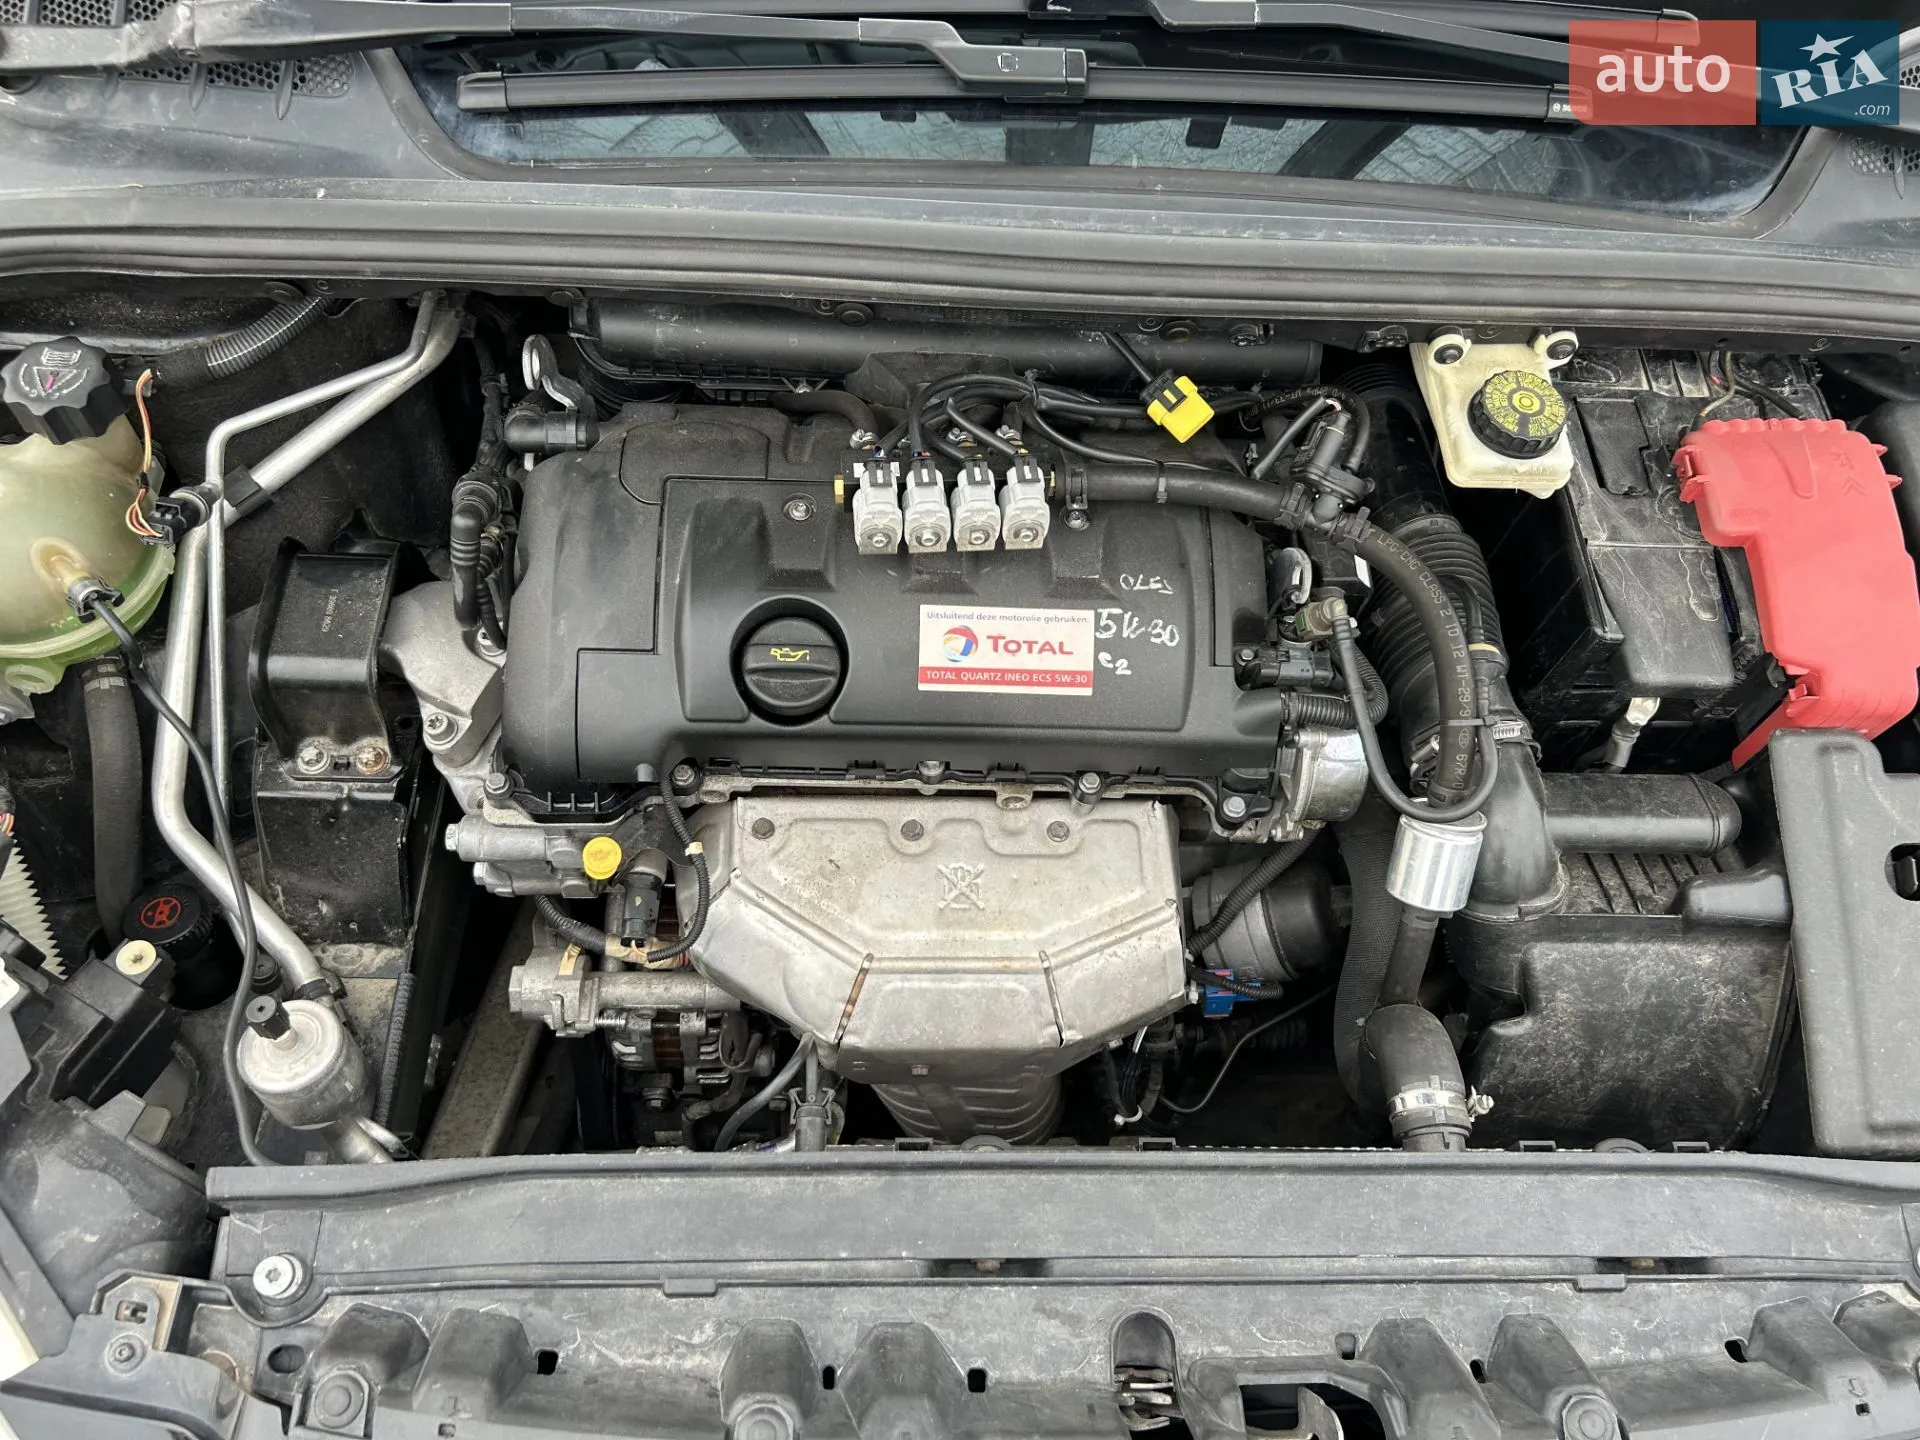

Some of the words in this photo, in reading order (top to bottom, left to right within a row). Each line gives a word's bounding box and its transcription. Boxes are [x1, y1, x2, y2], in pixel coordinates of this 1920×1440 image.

[1419, 571, 1446, 605] CLASS
[926, 611, 975, 621] Uitsluitend
[976, 612, 998, 621] deze
[999, 614, 1042, 622] motorolie
[1043, 615, 1091, 624] gebruiken.
[986, 634, 1074, 656] TOTAL
[926, 670, 958, 680] TOTAL
[960, 672, 1002, 682] QUARTZ
[1004, 673, 1030, 682] INEO
[1032, 674, 1052, 683] ECS
[1055, 675, 1088, 684] 5W-30
